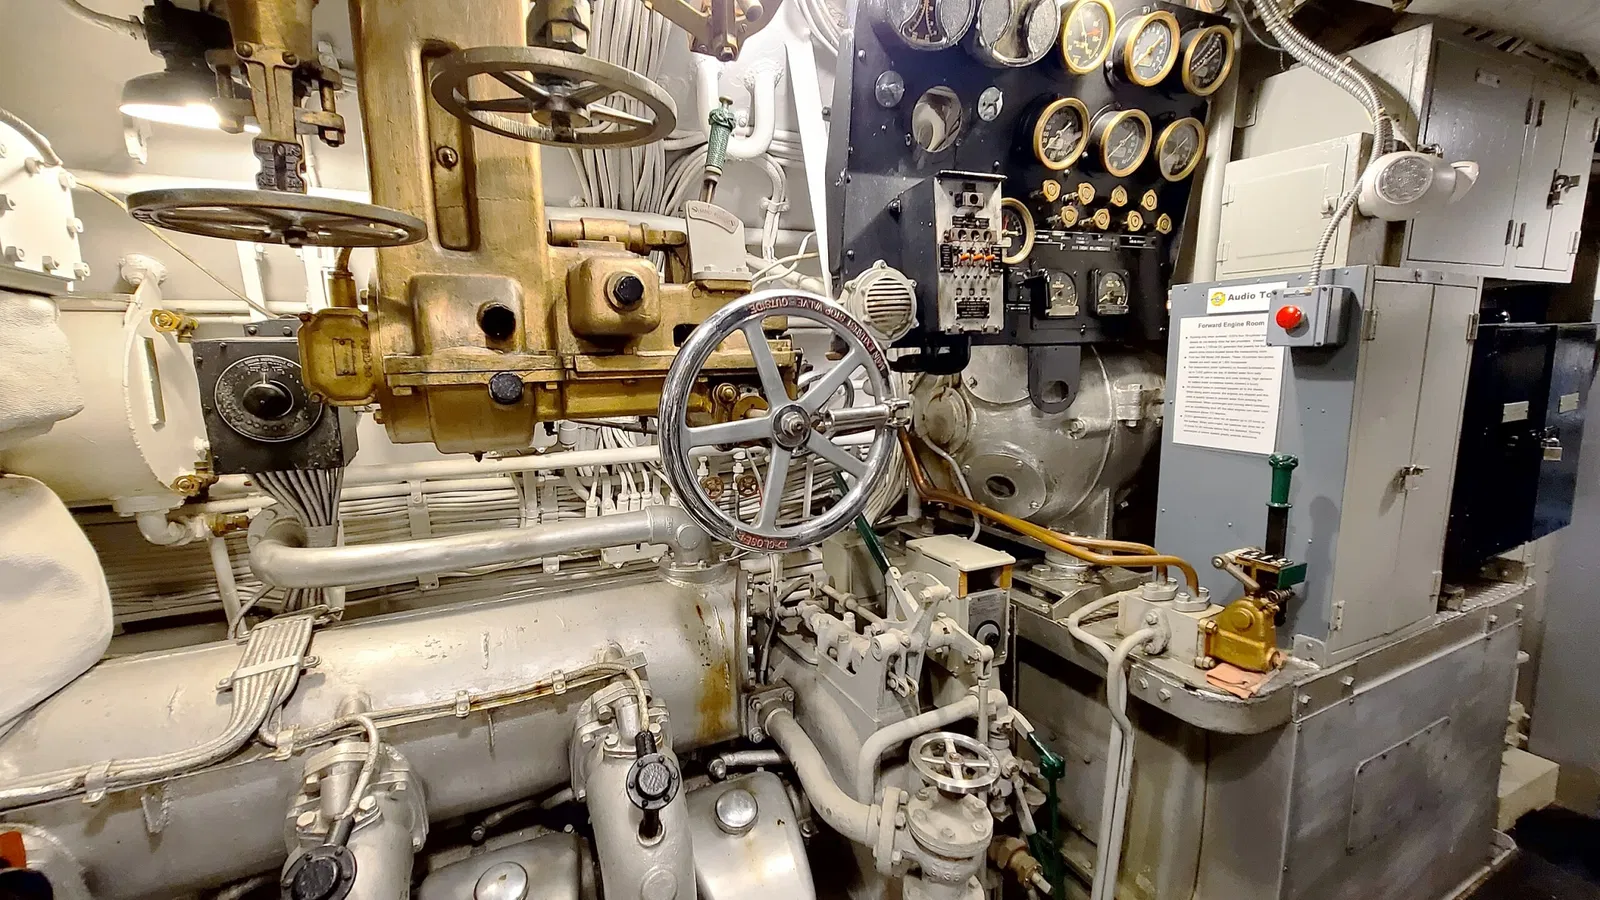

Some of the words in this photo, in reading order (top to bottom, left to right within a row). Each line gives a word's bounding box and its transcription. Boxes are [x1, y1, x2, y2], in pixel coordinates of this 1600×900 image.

[1228, 293, 1256, 301] Audio
[1259, 291, 1272, 299] To
[749, 297, 789, 314] OUTSIDE
[797, 298, 823, 312] VALVE
[824, 307, 847, 323] STOP
[1223, 321, 1244, 329] Engine
